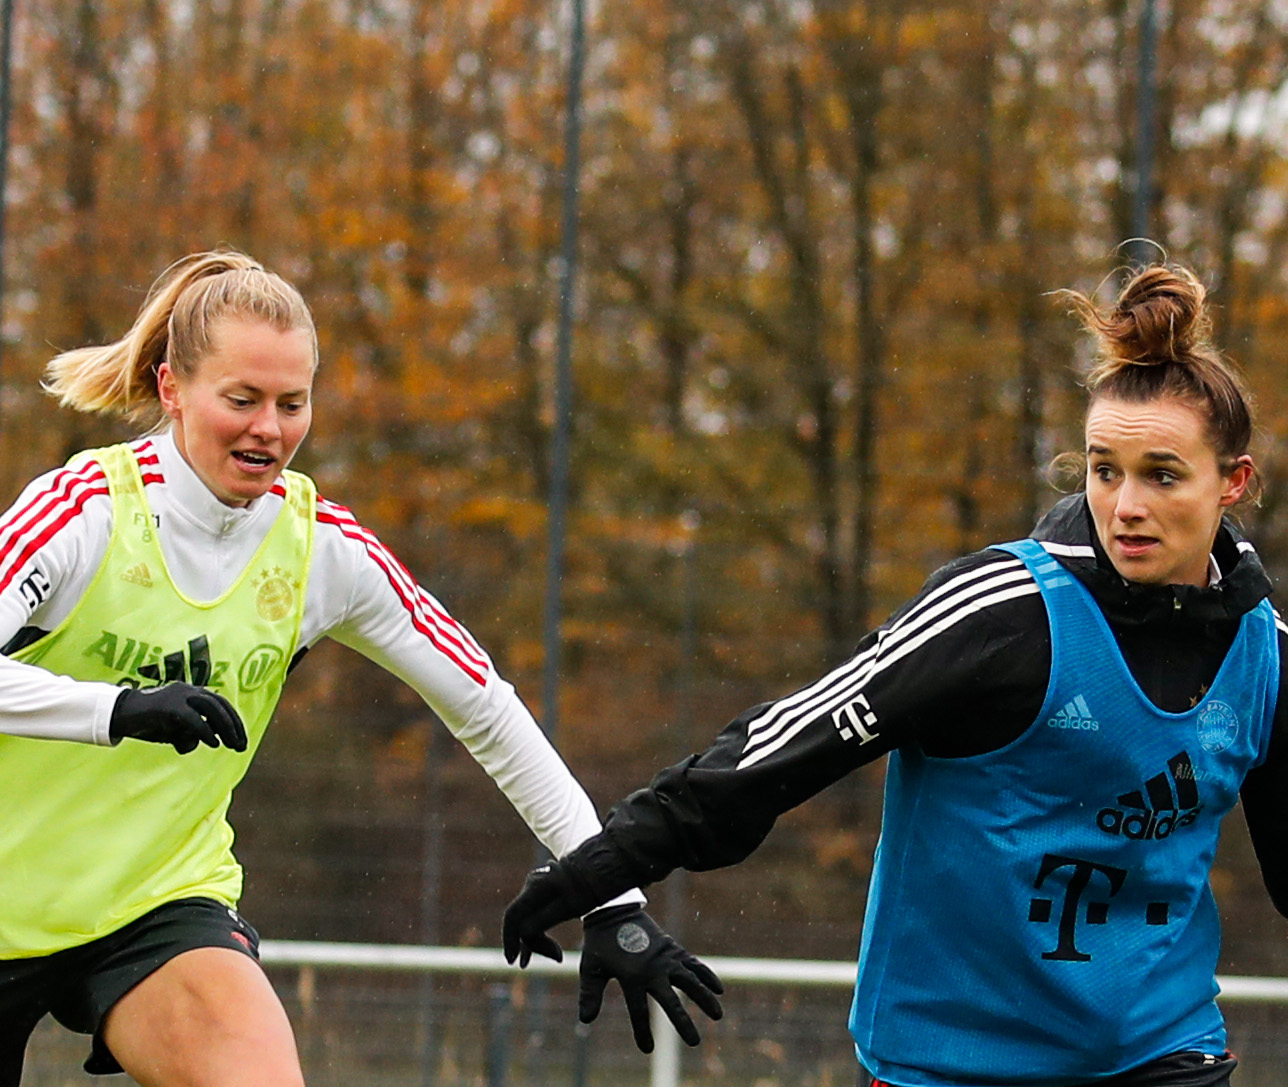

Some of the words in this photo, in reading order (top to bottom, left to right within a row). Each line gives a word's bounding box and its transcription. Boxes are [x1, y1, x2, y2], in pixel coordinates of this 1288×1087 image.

[142, 530, 152, 543] 8
[82, 630, 229, 687] Alliz
[1048, 717, 1099, 731] adidas
